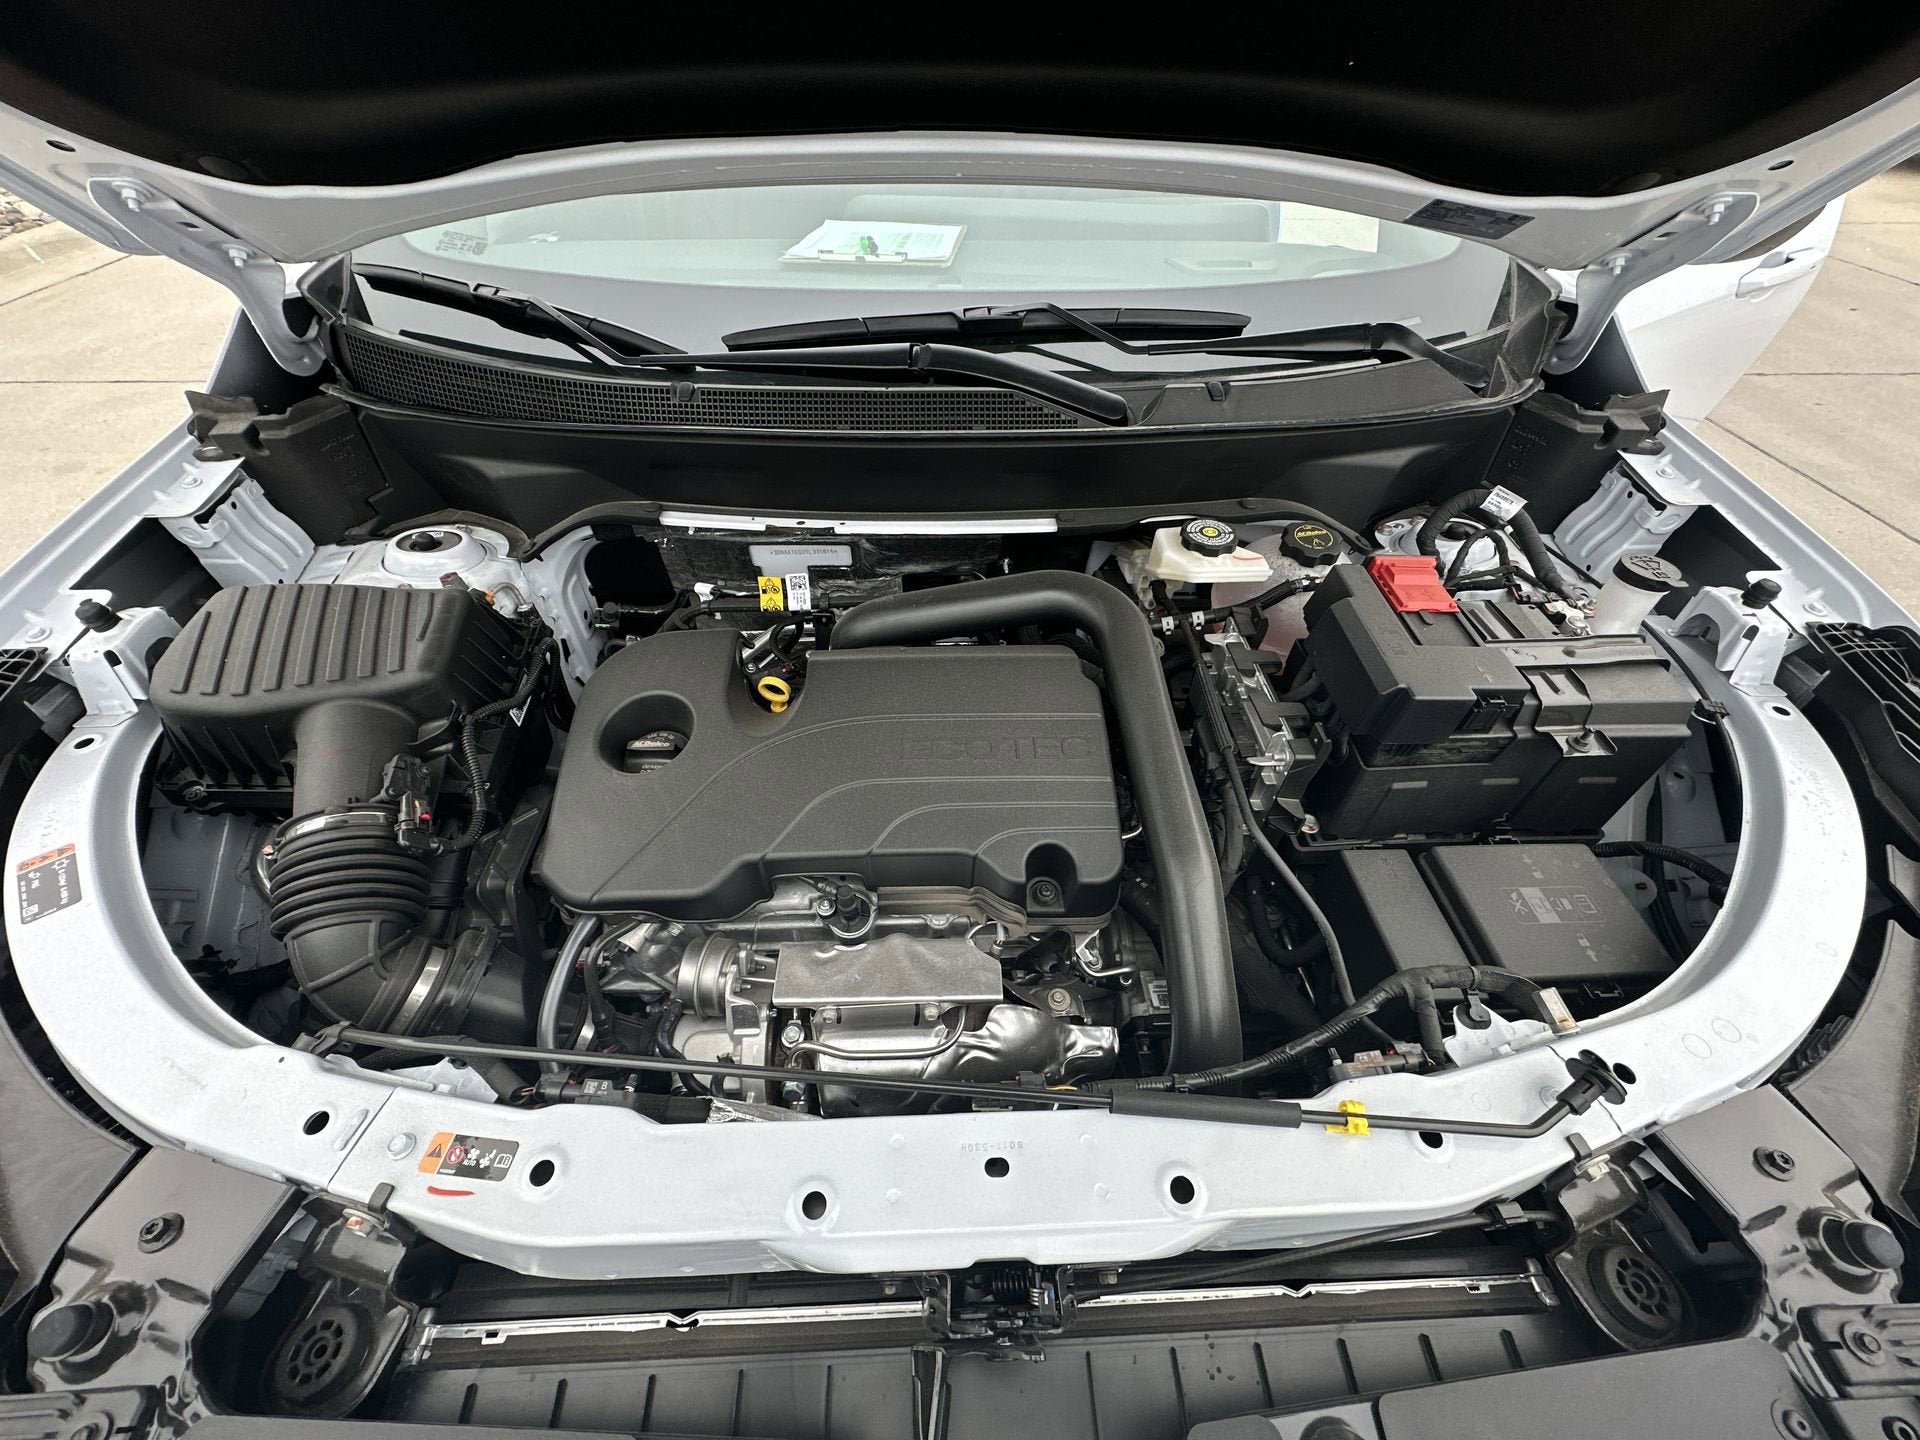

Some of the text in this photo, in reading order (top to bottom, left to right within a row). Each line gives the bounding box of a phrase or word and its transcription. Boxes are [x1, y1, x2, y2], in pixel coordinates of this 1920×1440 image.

[630, 740, 670, 748] ACDelco
[901, 736, 1094, 760] ECOTEC
[462, 1158, 477, 1167] AUTO
